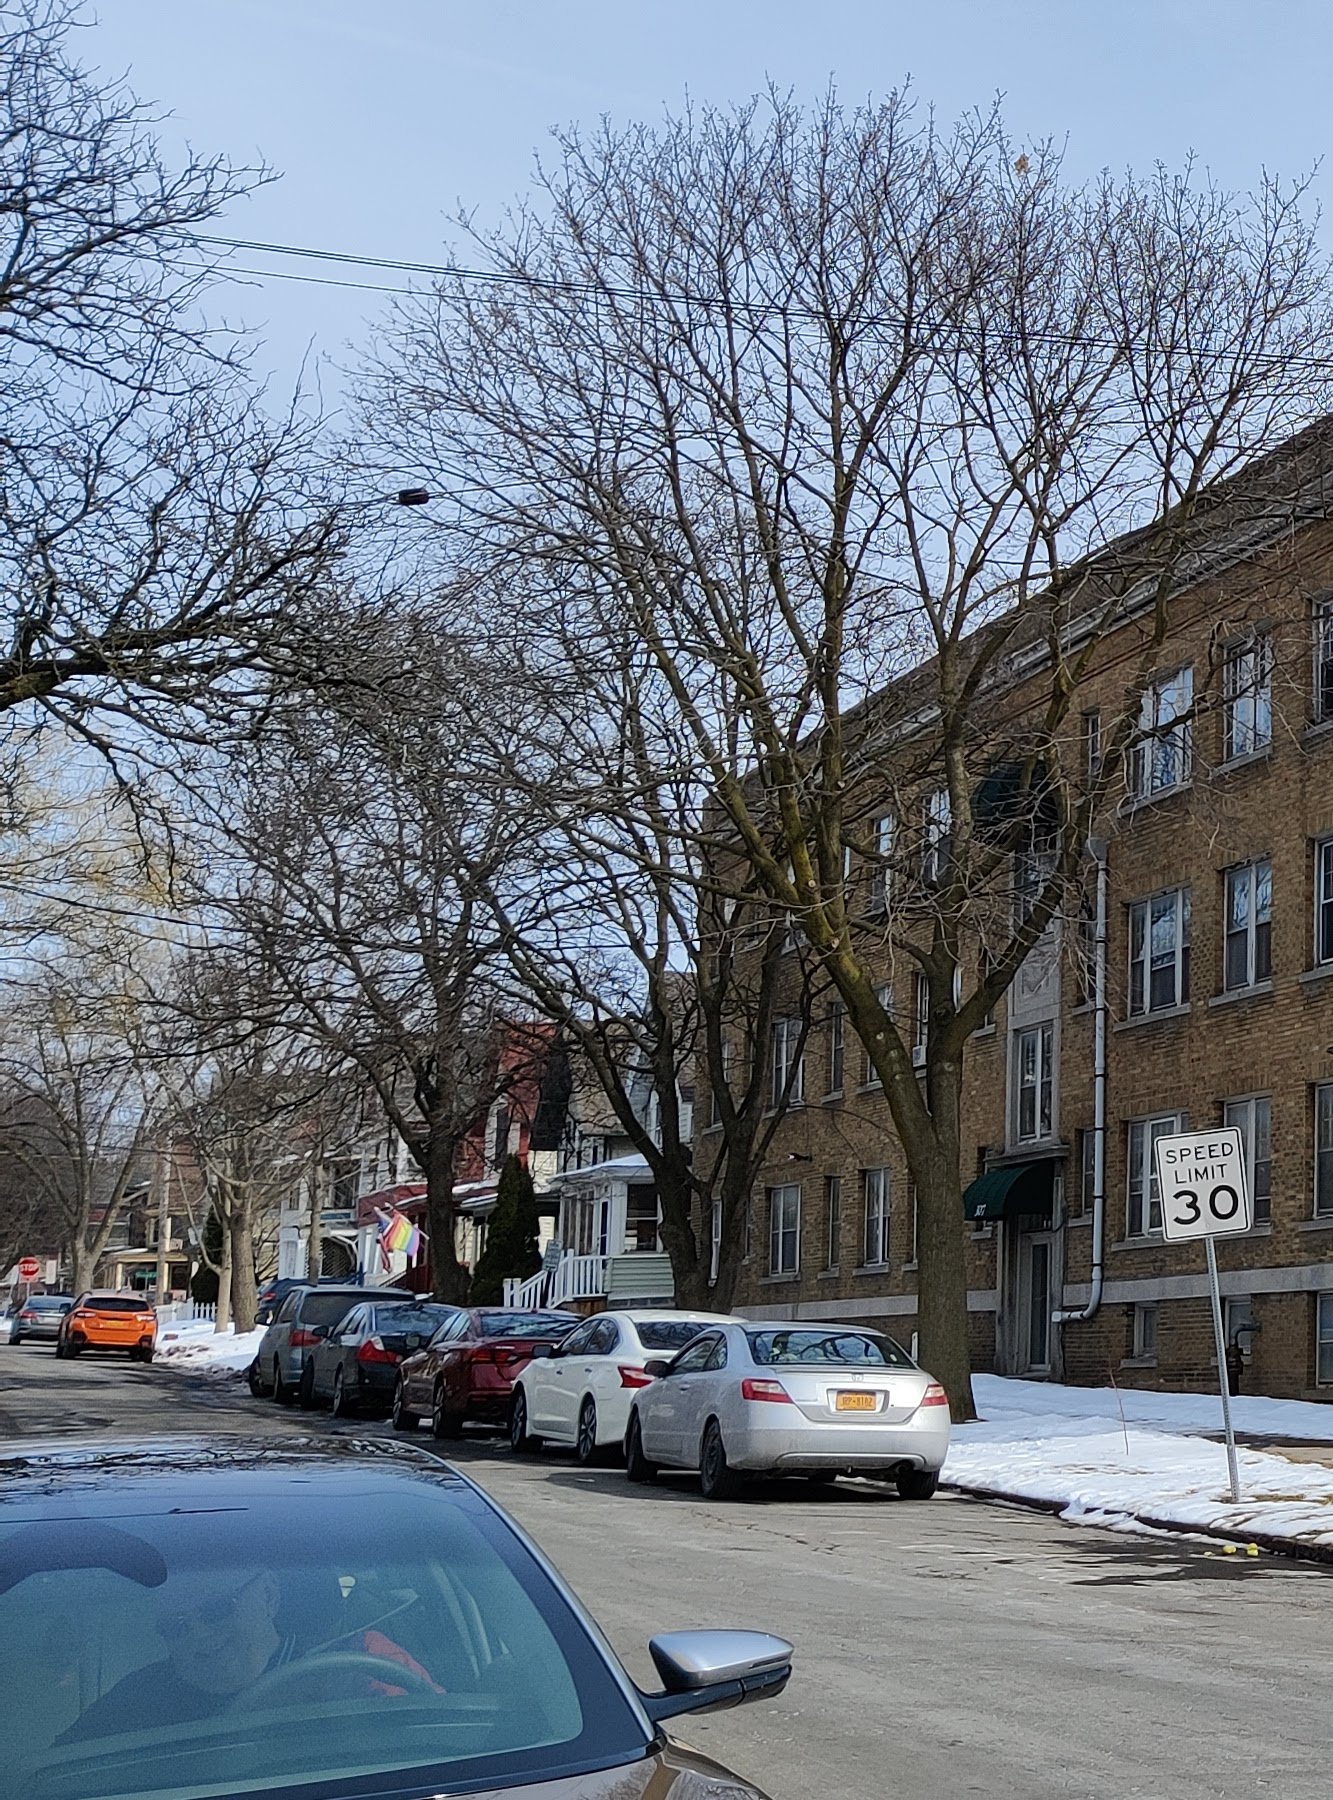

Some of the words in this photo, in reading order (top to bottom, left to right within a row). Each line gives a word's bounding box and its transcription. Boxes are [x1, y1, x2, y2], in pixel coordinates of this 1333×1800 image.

[1166, 1142, 1234, 1164] SPEED
[1174, 1163, 1227, 1184] LIMIT
[1173, 1185, 1239, 1225] 30
[20, 1263, 39, 1271] STOP
